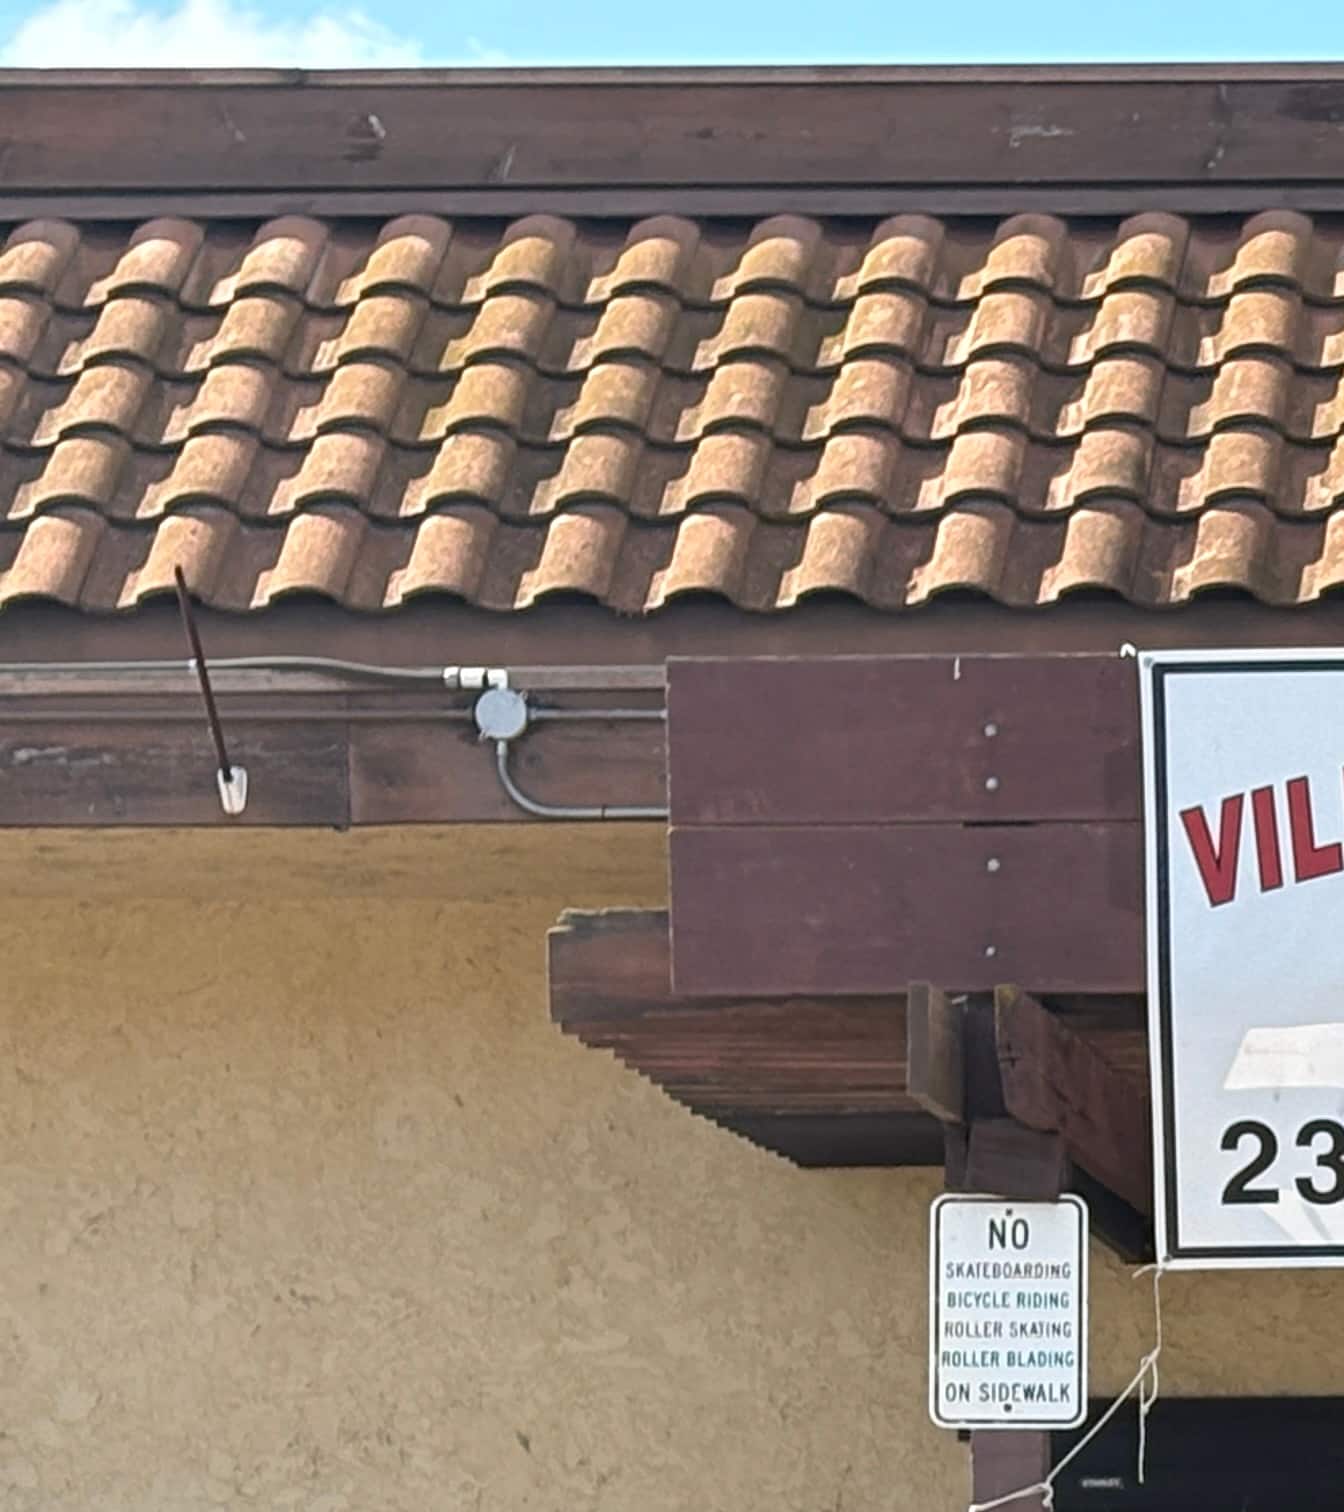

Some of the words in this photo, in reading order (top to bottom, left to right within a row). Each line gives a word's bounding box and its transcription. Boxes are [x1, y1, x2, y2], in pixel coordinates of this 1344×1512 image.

[989, 1218, 1028, 1250] NO
[946, 1262, 1070, 1279] SKATEBOARDING
[947, 1291, 1009, 1309] BICYCLE
[1017, 1292, 1069, 1309] RIDING
[945, 1321, 1002, 1338] ROLLER
[1009, 1321, 1071, 1338] SKATING
[942, 1351, 999, 1368] ROLLER
[1007, 1350, 1074, 1367] BLADING
[946, 1383, 969, 1403] ON
[979, 1382, 1069, 1403] SIDEWALK
